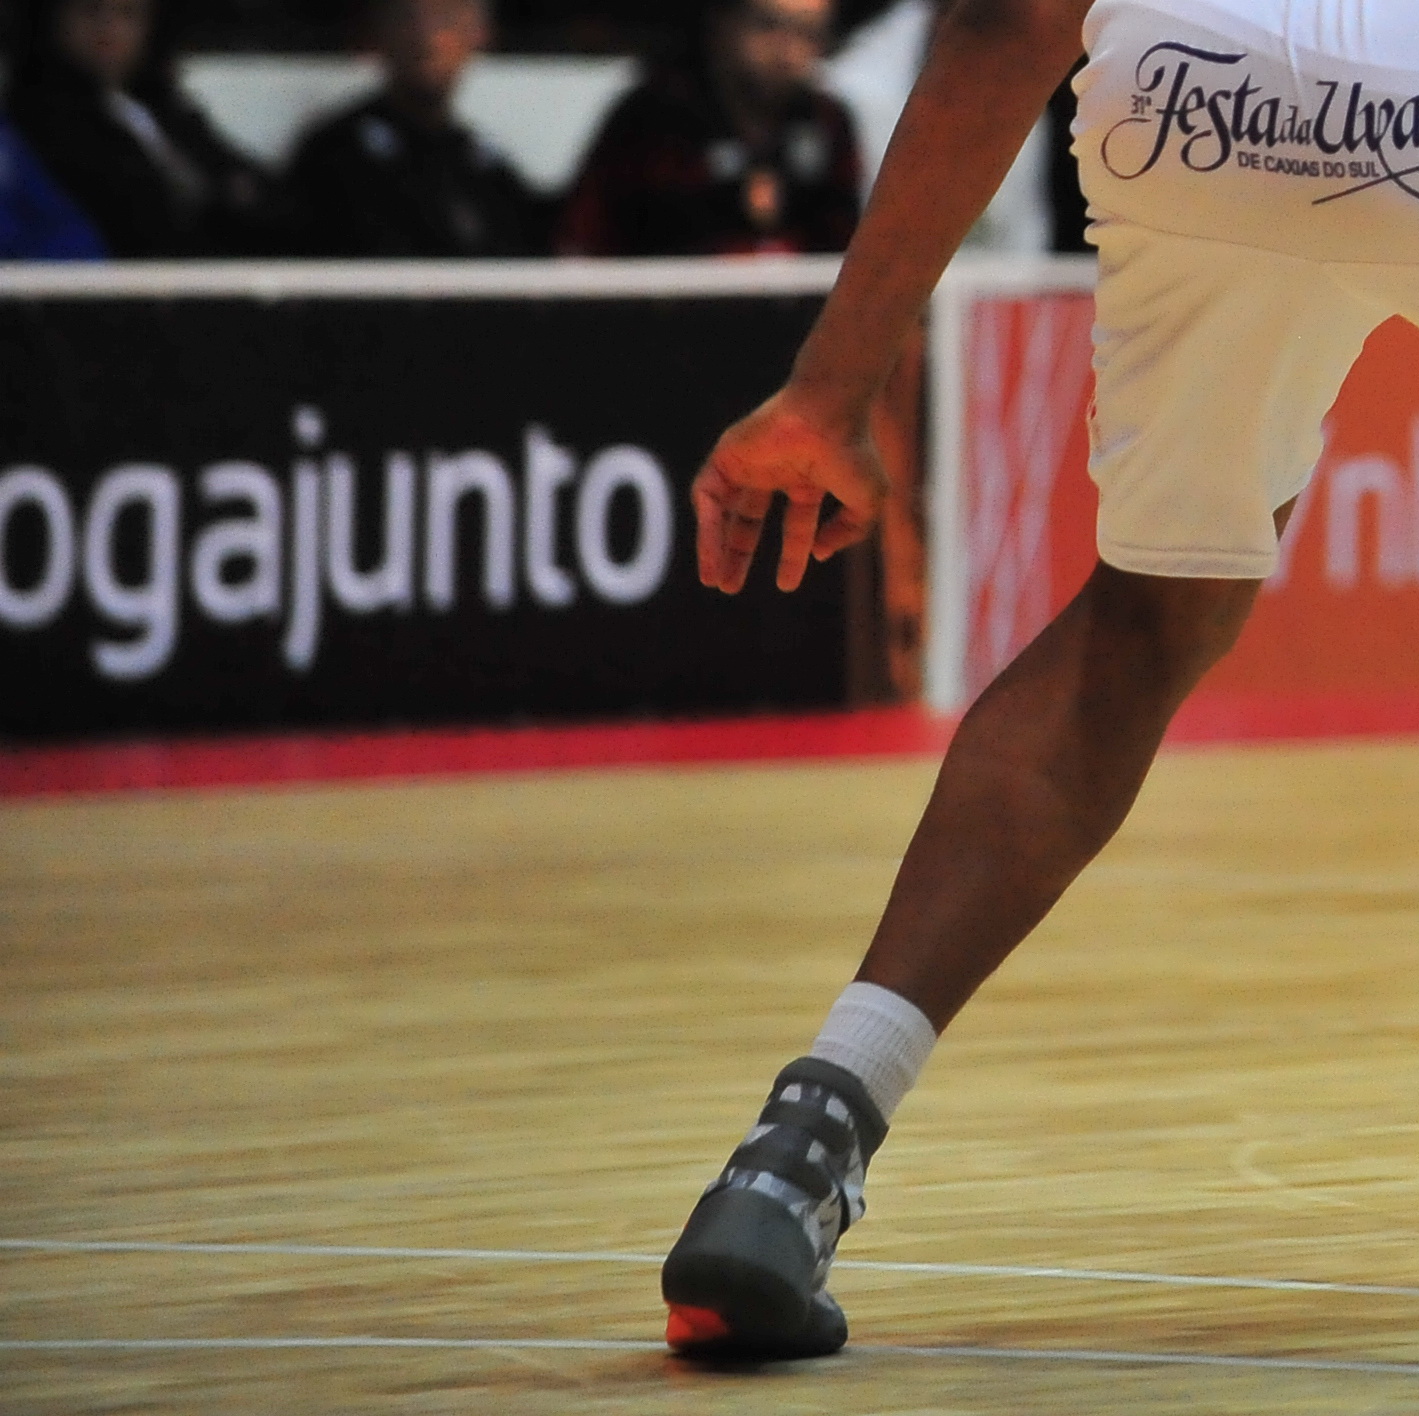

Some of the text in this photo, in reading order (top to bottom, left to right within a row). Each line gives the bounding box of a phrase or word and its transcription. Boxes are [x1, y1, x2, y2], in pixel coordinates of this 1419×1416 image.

[1102, 41, 1281, 179] Festa
[1280, 104, 1315, 146] da
[1237, 150, 1381, 179] DE CAXIAS DO SUL
